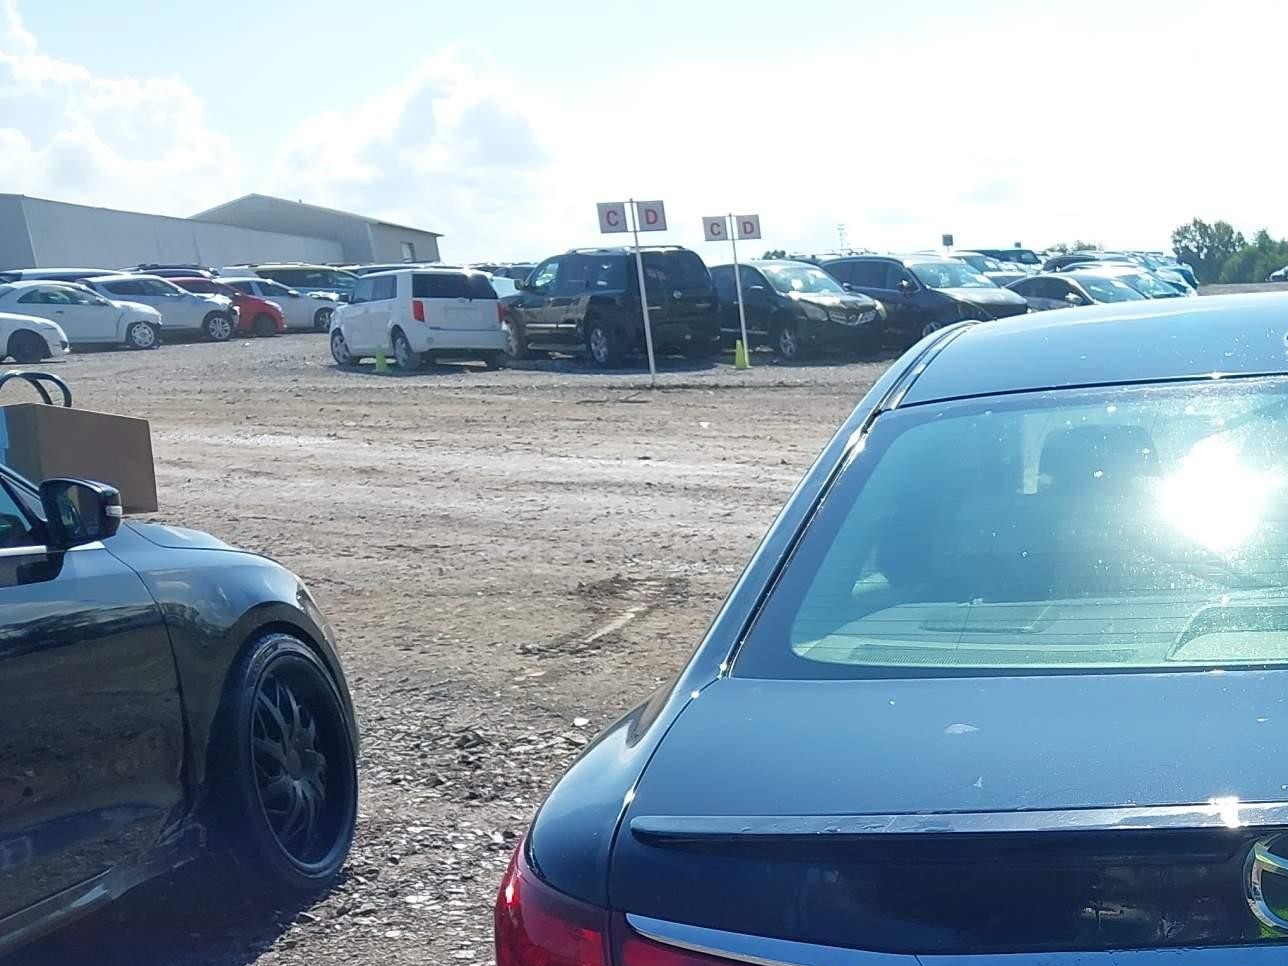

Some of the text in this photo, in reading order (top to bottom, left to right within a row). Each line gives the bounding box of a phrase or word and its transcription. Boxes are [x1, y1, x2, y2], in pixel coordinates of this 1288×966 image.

[605, 208, 658, 227] C D
[710, 220, 754, 236] C D
